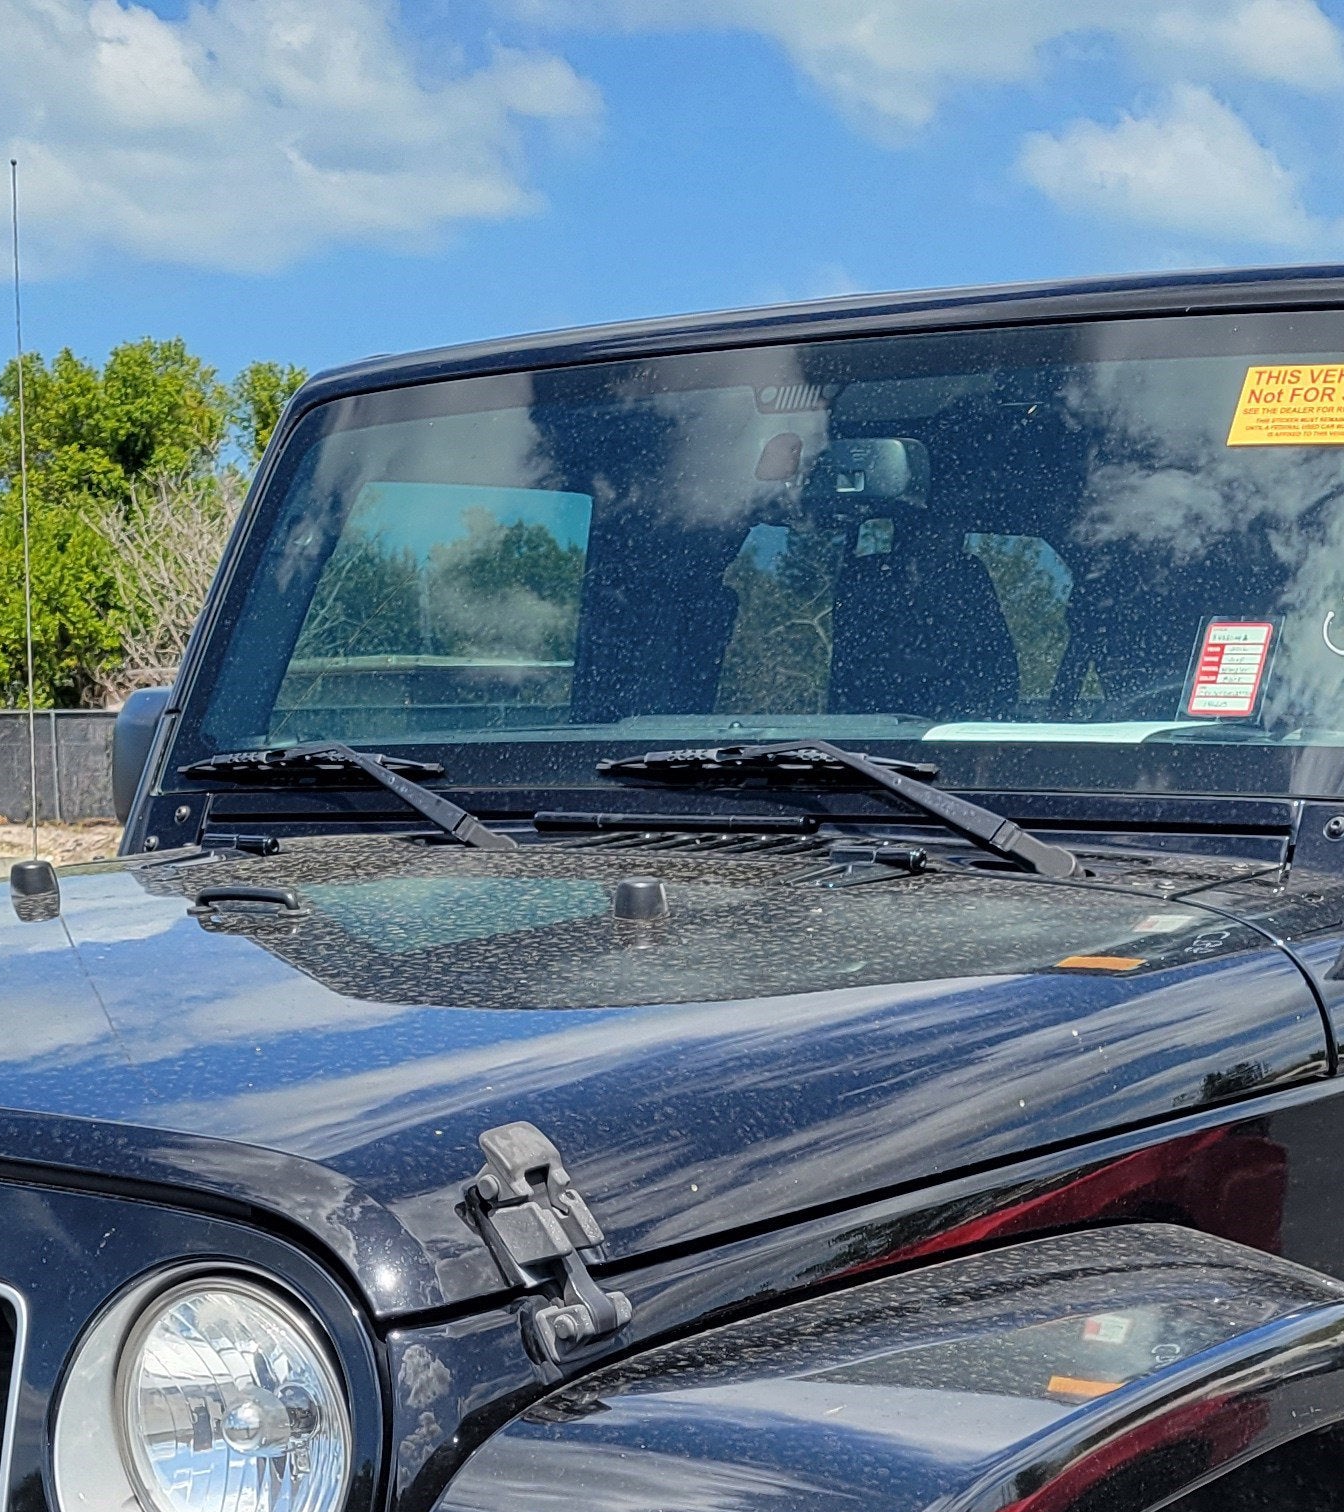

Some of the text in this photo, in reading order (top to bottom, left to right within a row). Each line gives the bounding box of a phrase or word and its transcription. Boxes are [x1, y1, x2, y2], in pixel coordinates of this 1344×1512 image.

[1255, 369, 1302, 386] THIS
[1247, 388, 1285, 404] Not
[1289, 386, 1336, 403] FOR
[1242, 407, 1260, 415] SEE
[1280, 406, 1315, 414] DEALER
